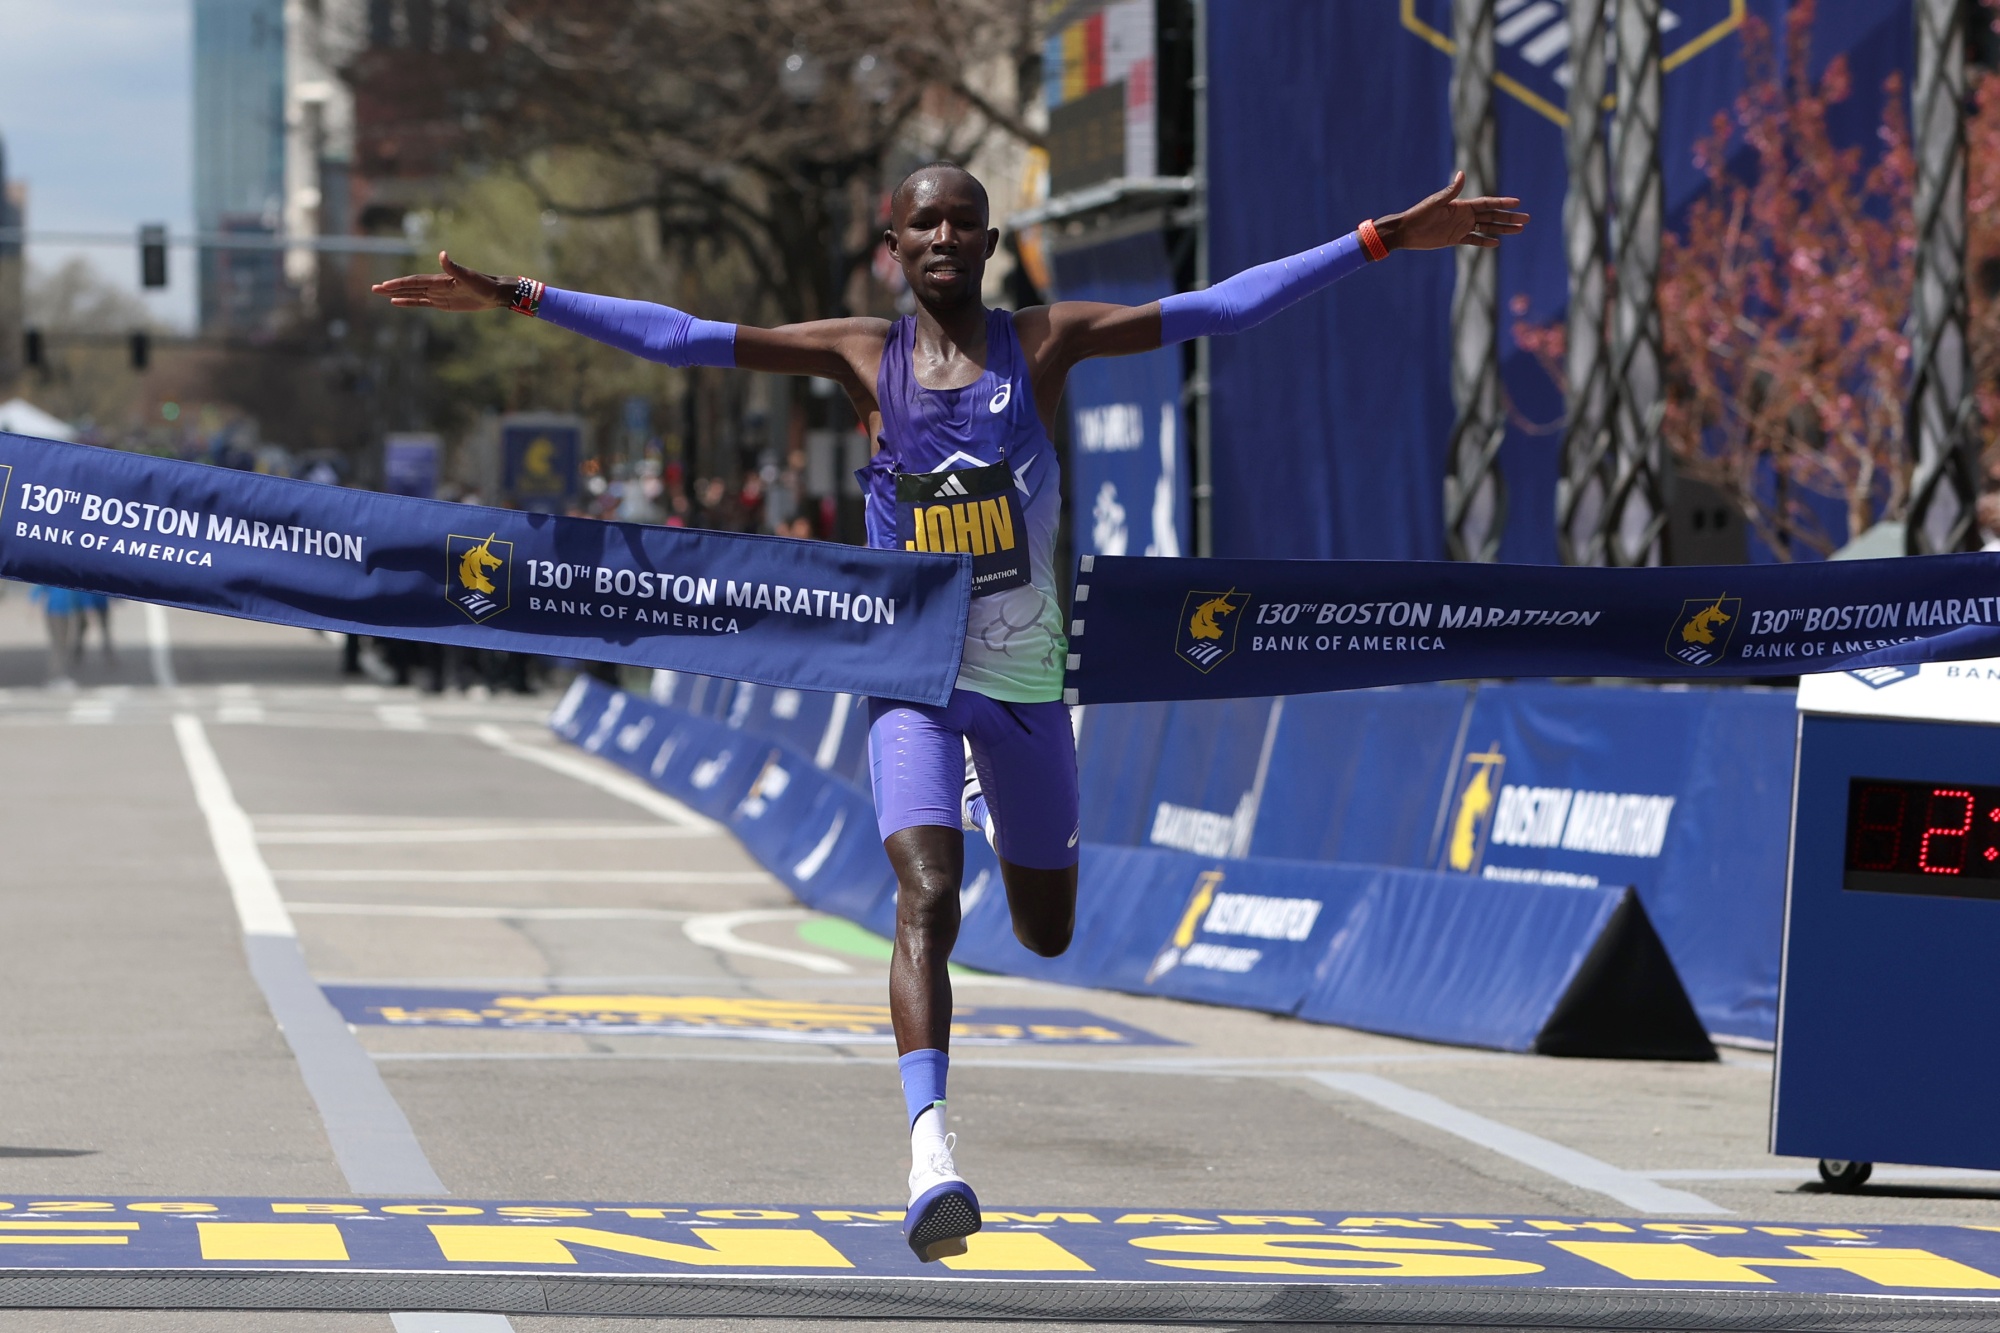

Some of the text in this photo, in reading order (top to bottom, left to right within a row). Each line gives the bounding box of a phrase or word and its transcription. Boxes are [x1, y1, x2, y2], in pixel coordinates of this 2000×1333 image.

[21, 484, 363, 562] 130TH BOSTON MARATHON
[905, 495, 1015, 557] JOHN
[16, 522, 213, 567] BANK OF AMERICA
[526, 559, 895, 625] 130TH BOSTON MARATHON
[976, 568, 1018, 584] MARATHON
[529, 597, 739, 634] BANK OF AMERICA
[1255, 602, 1601, 628] 130TH BOSTON MARATHON
[1750, 608, 1804, 635] 130TH
[1803, 602, 1901, 632] BOSTON
[1252, 635, 1446, 651] BANK OF AMERICA
[1741, 642, 1795, 658] BANK
[1801, 641, 1825, 656] OF
[0, 1201, 1867, 1239] 26 BOSTON MARATHON
